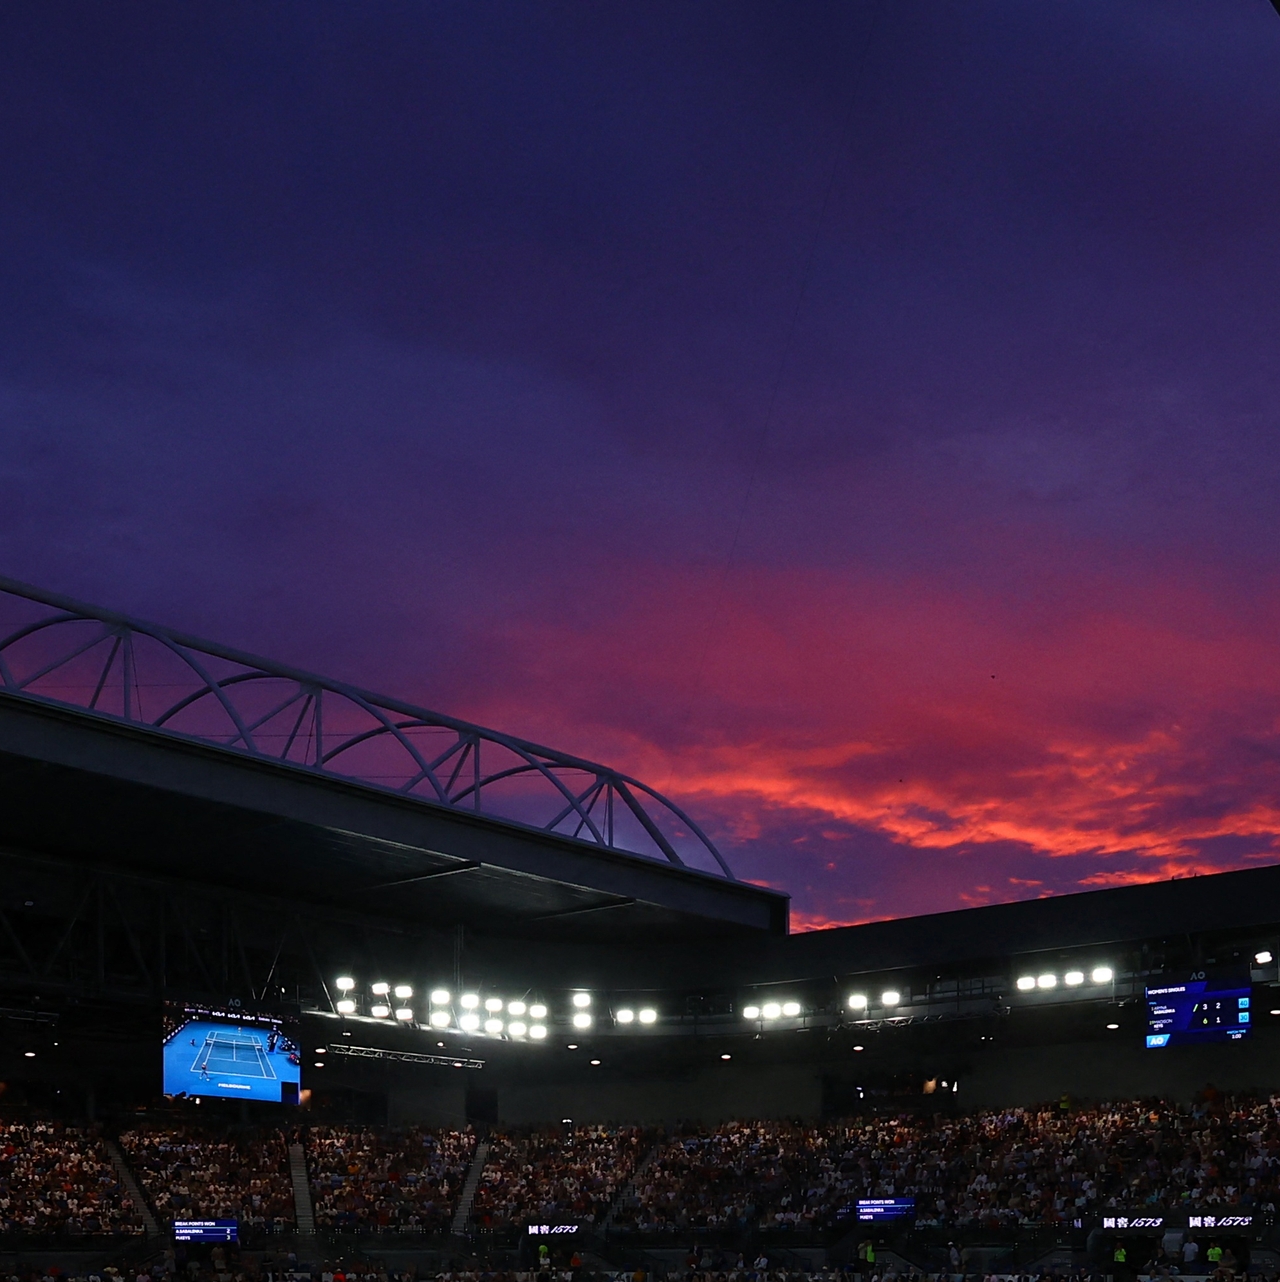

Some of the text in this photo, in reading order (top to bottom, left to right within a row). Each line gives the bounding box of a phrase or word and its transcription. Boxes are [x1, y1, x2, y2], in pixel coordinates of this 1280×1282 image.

[1202, 1003, 1208, 1011] 3
[1240, 1013, 1248, 1021] 30
[1150, 1037, 1164, 1046] AO
